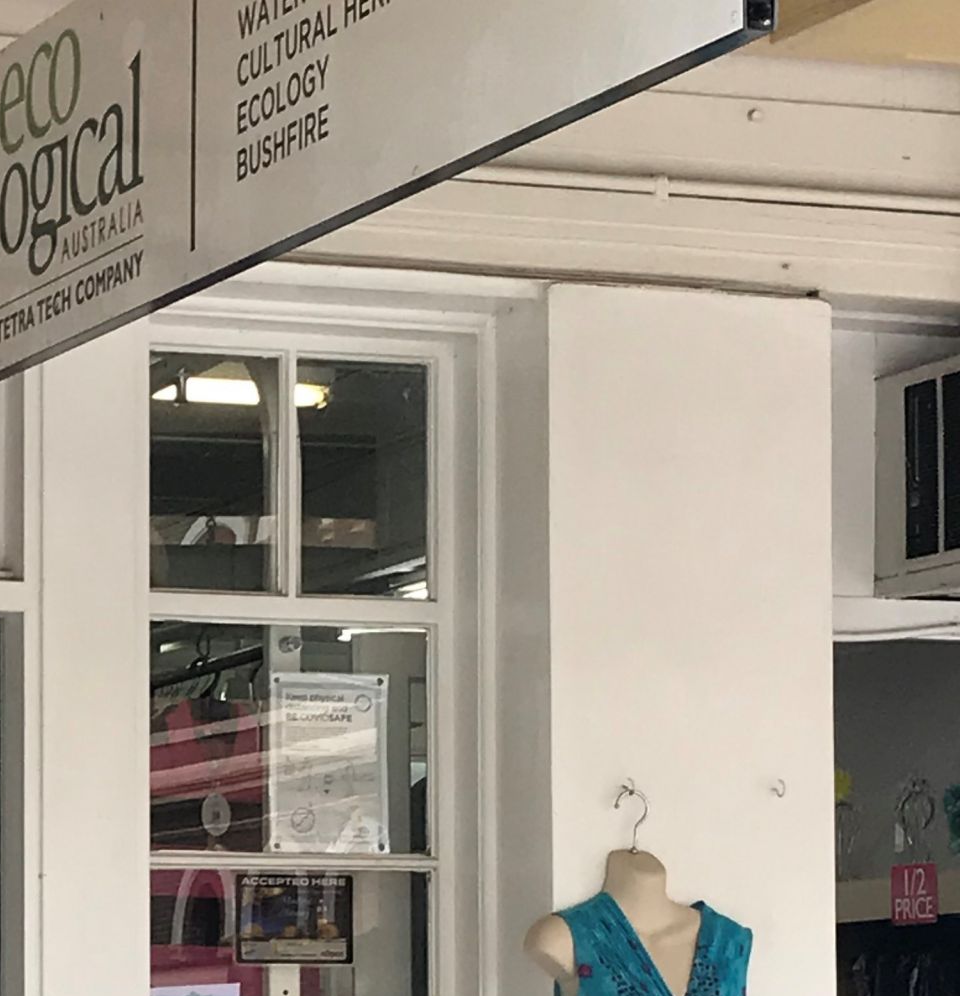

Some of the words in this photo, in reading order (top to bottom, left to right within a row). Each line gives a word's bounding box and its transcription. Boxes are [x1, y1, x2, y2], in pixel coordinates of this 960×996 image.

[237, 4, 337, 86] CULTURAL
[344, 0, 390, 28] HE
[238, 0, 306, 39] WATE
[0, 28, 81, 154] eco
[237, 54, 329, 135] ECOLOGY
[237, 103, 329, 182] BUSHFIRE
[60, 198, 144, 264] AUSTRALIA
[37, 284, 72, 324] TECH
[75, 249, 144, 305] COMPANY
[241, 877, 310, 886] ACCEPTED
[312, 878, 346, 886] HERE
[895, 896, 934, 920] PRICE
[904, 868, 927, 896] 1/2
